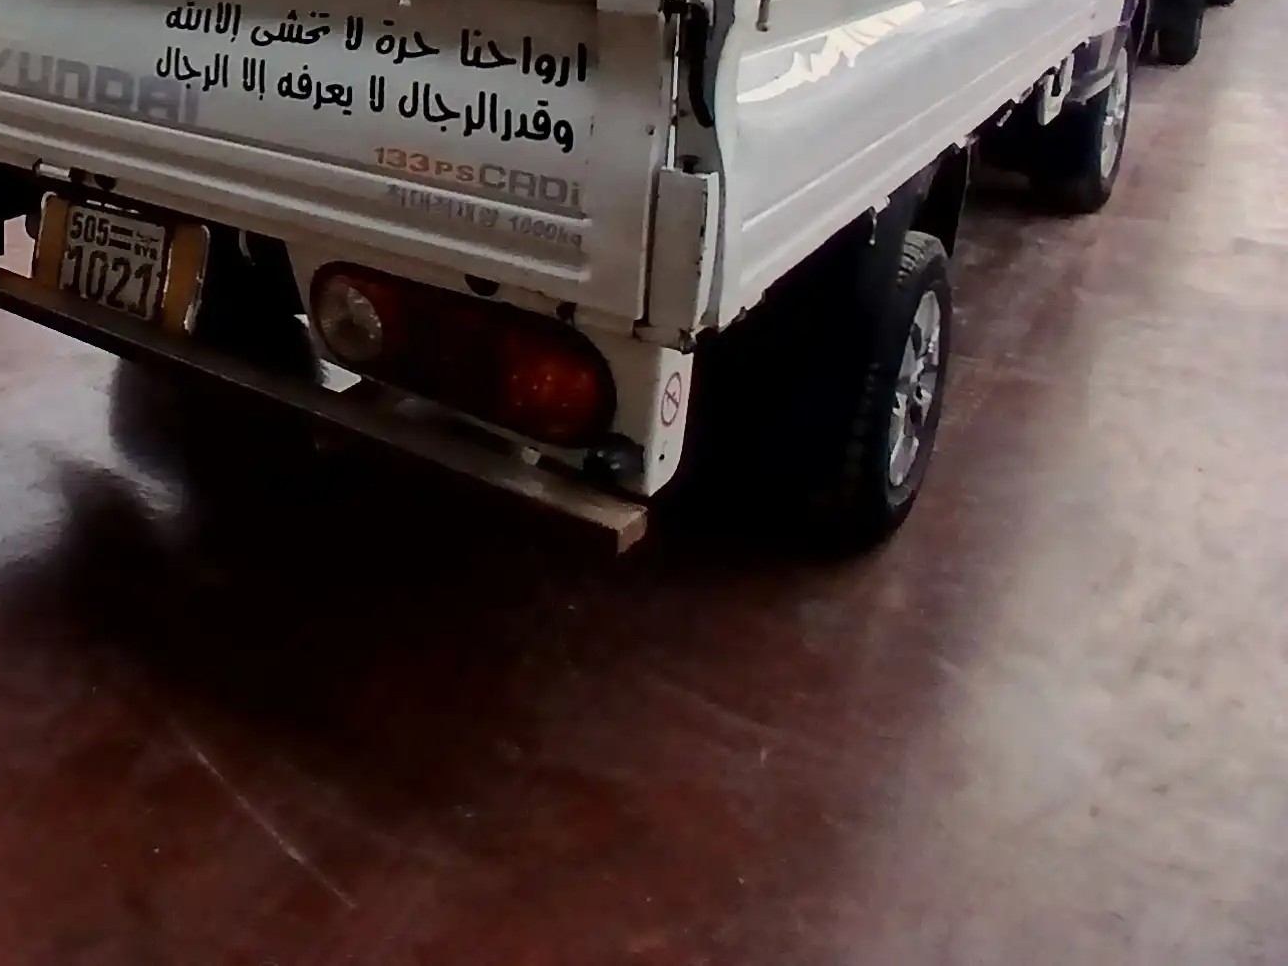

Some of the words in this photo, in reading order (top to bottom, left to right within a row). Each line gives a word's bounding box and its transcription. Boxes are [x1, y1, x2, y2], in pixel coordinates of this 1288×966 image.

[345, 15, 363, 51] لا
[376, 19, 440, 65] حرة
[156, 46, 230, 92] الرجال
[369, 75, 385, 113] لا
[70, 211, 110, 247] 505
[66, 244, 154, 318] 1021
